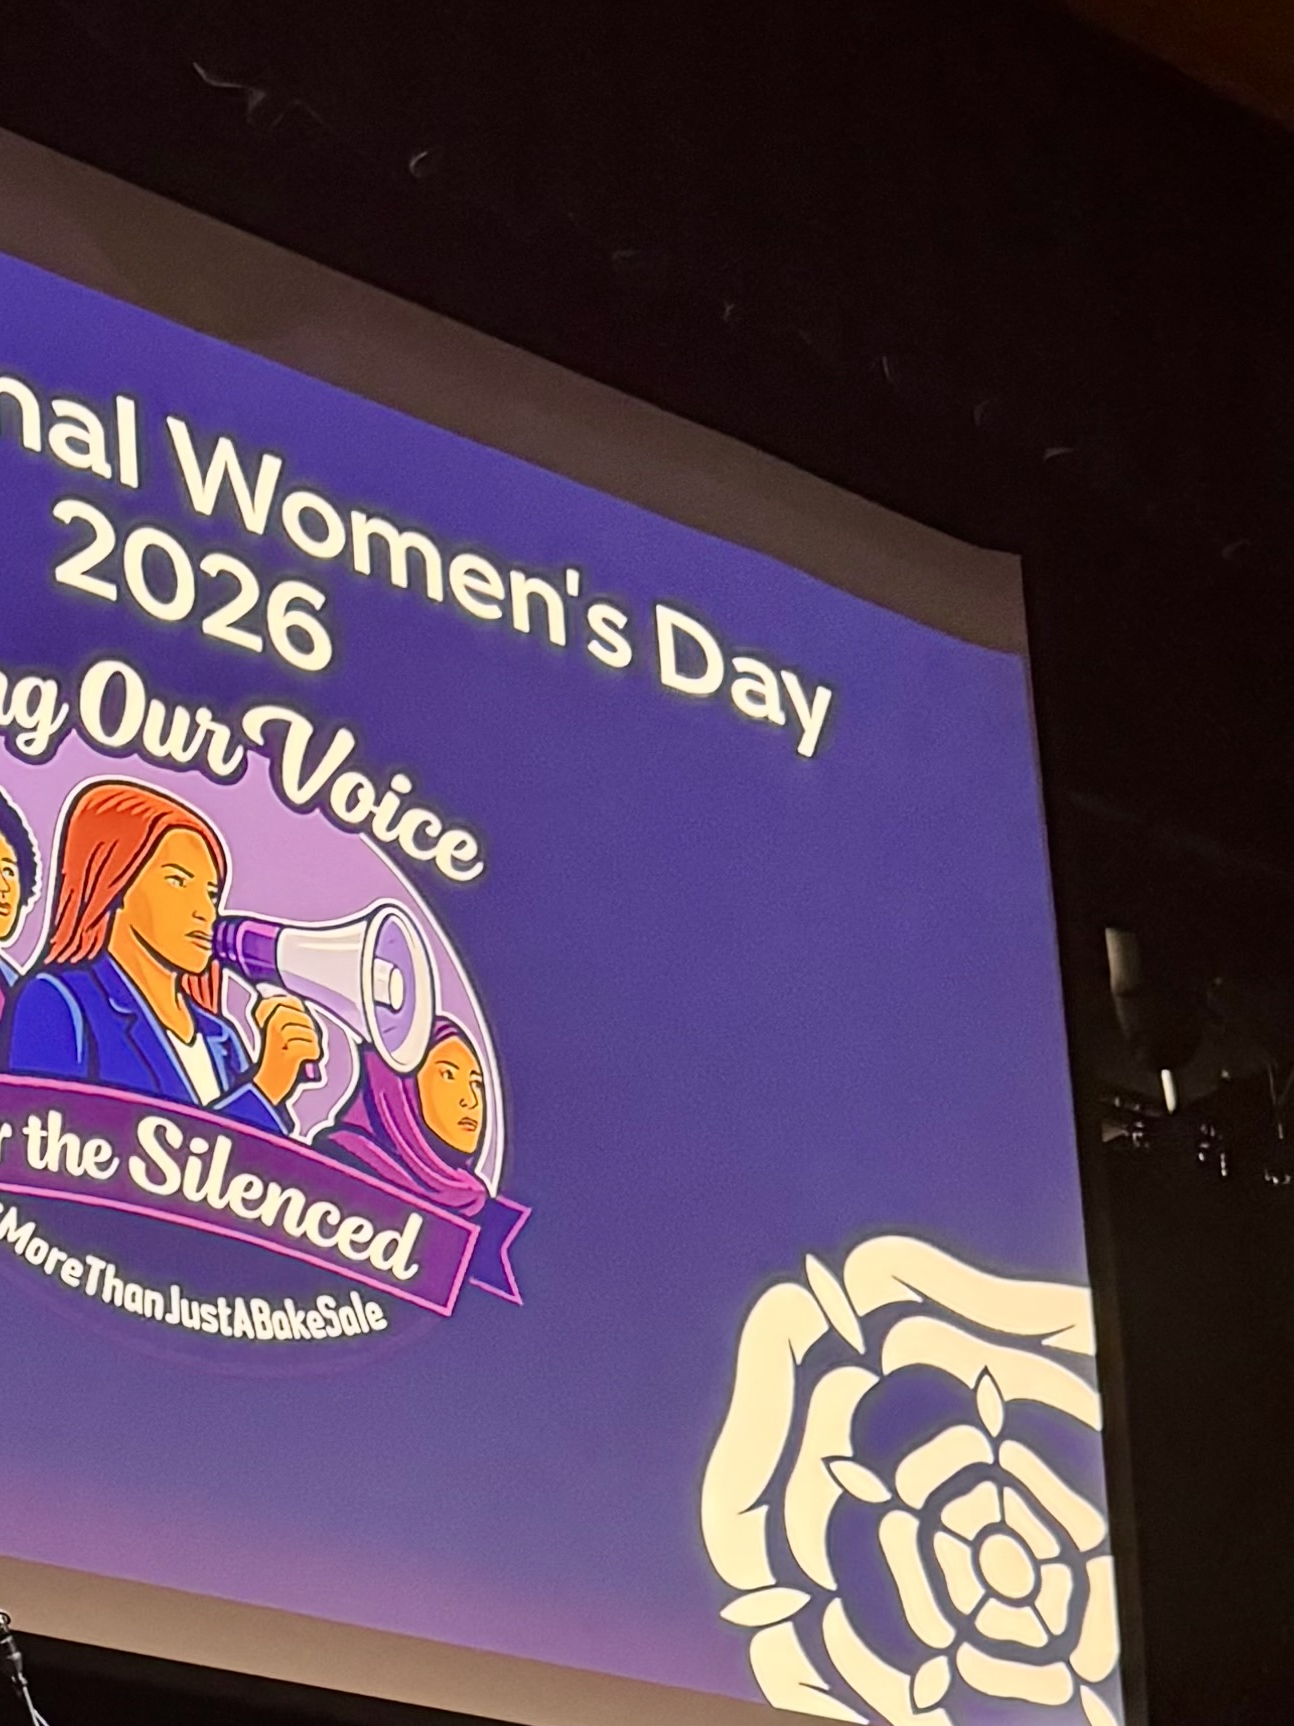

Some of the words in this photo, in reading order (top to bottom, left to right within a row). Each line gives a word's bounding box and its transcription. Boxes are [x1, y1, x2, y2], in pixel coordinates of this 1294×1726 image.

[52, 498, 333, 672] 2026
[165, 415, 633, 669] Women's
[654, 603, 833, 758] Day
[78, 659, 245, 774] Our
[242, 704, 485, 882] Voice
[21, 1109, 121, 1181] the
[127, 1115, 424, 1281] Silenced
